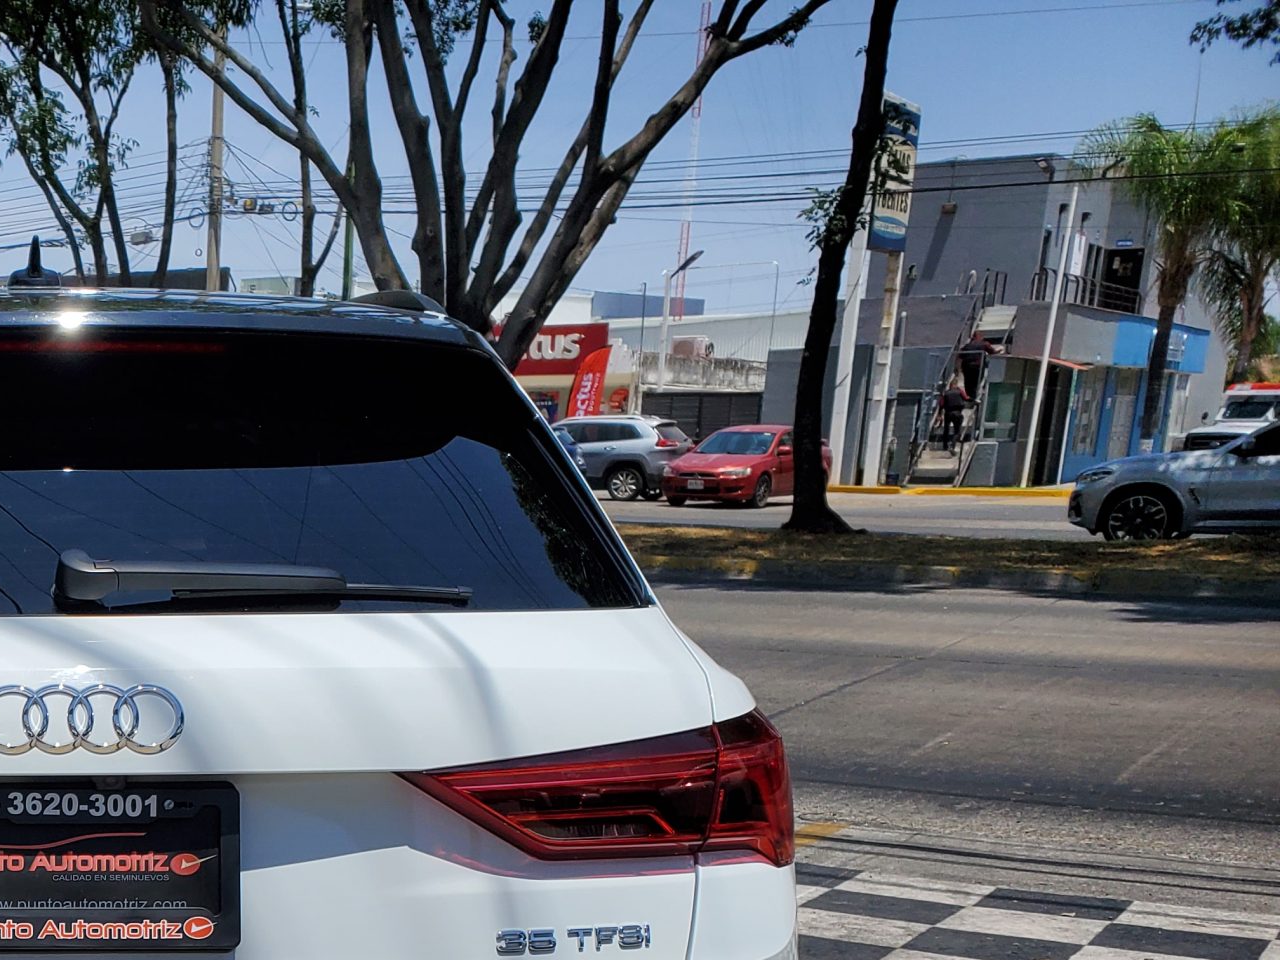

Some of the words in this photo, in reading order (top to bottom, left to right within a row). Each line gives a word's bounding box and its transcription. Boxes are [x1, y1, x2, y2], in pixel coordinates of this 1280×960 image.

[7, 791, 158, 817] 3620-3001
[496, 929, 556, 956] 35
[567, 923, 651, 952] TFSI
